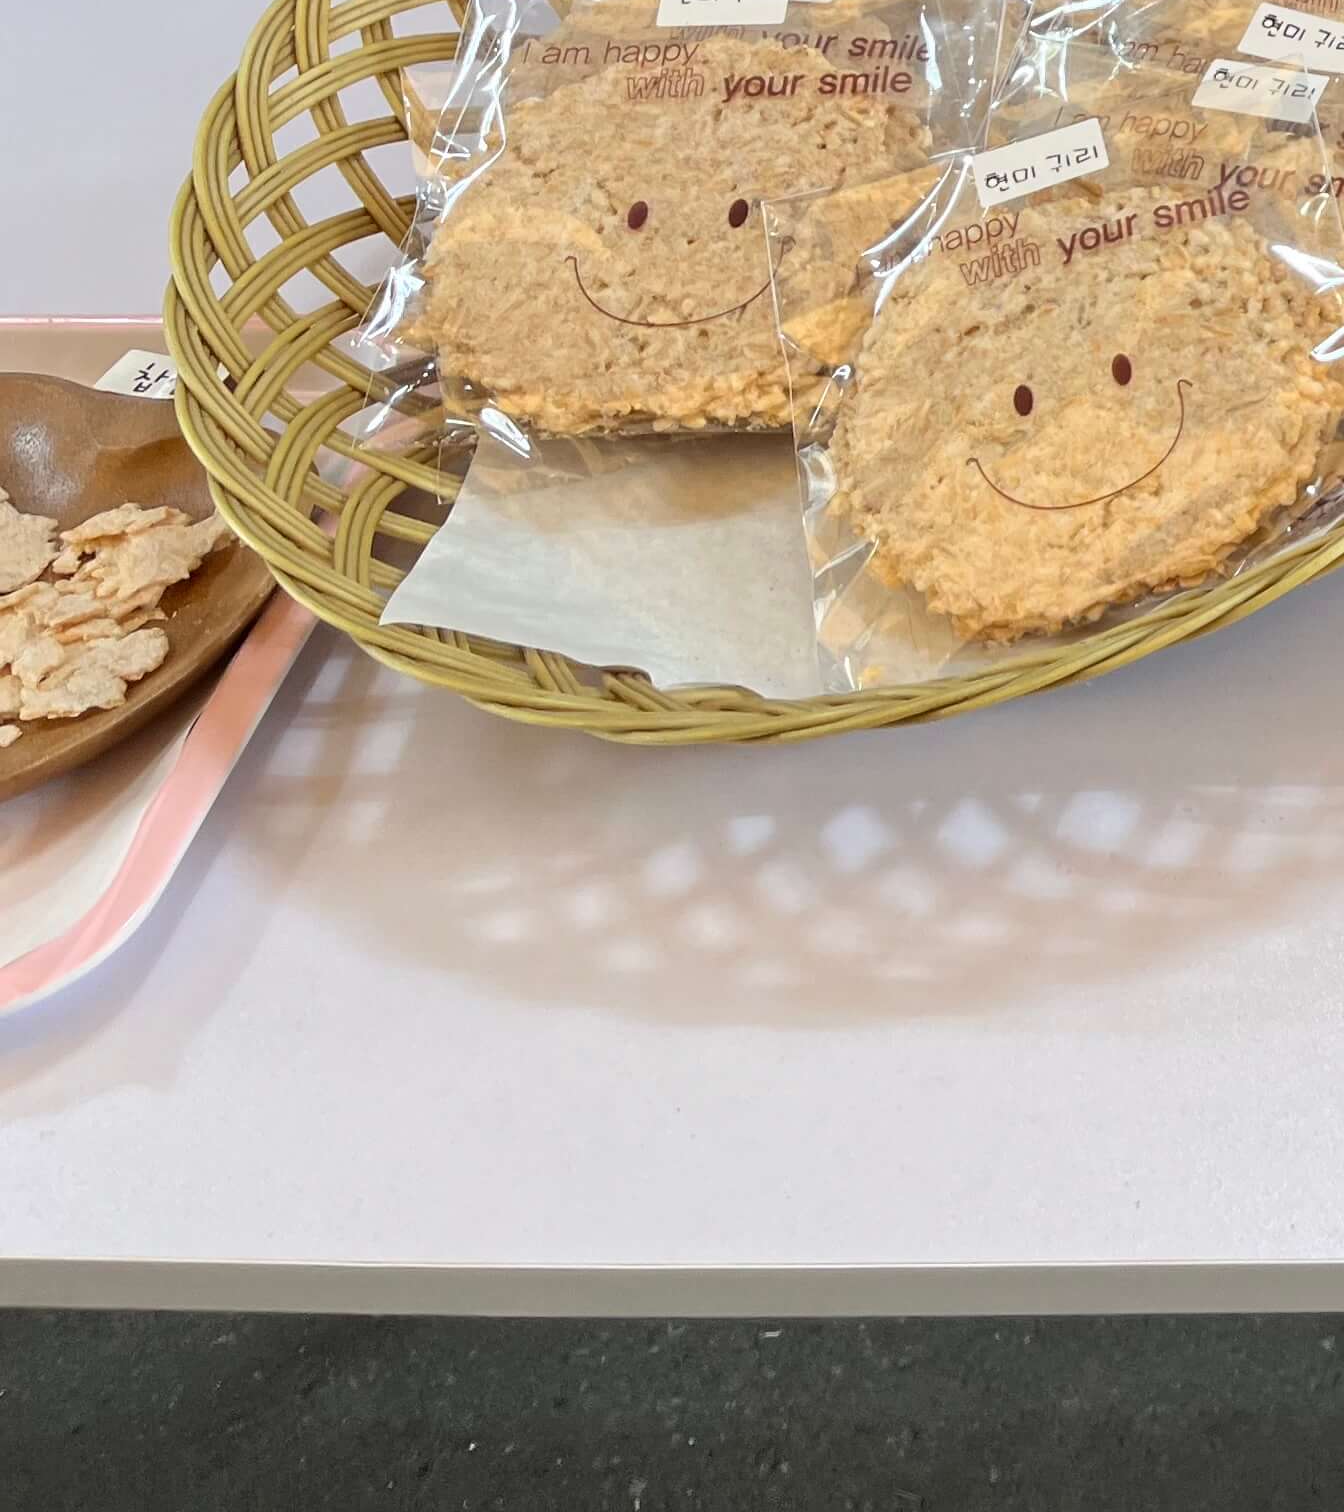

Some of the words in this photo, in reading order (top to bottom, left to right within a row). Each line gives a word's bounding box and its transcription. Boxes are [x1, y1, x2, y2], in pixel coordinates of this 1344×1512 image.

[1261, 13, 1306, 41] 현미
[541, 45, 591, 66] am
[603, 39, 700, 71] happy
[848, 34, 932, 63] smile
[625, 67, 705, 101] with
[722, 72, 804, 105] your
[818, 66, 914, 96] smile
[1212, 67, 1257, 90] 현미
[1271, 77, 1316, 99] 귀리
[1118, 110, 1208, 143] happy
[984, 166, 1037, 192] 현미
[1045, 145, 1099, 173] 귀리
[1218, 160, 1296, 190] your
[960, 238, 1041, 287] with
[1056, 212, 1138, 264] your
[1153, 188, 1251, 230] smile
